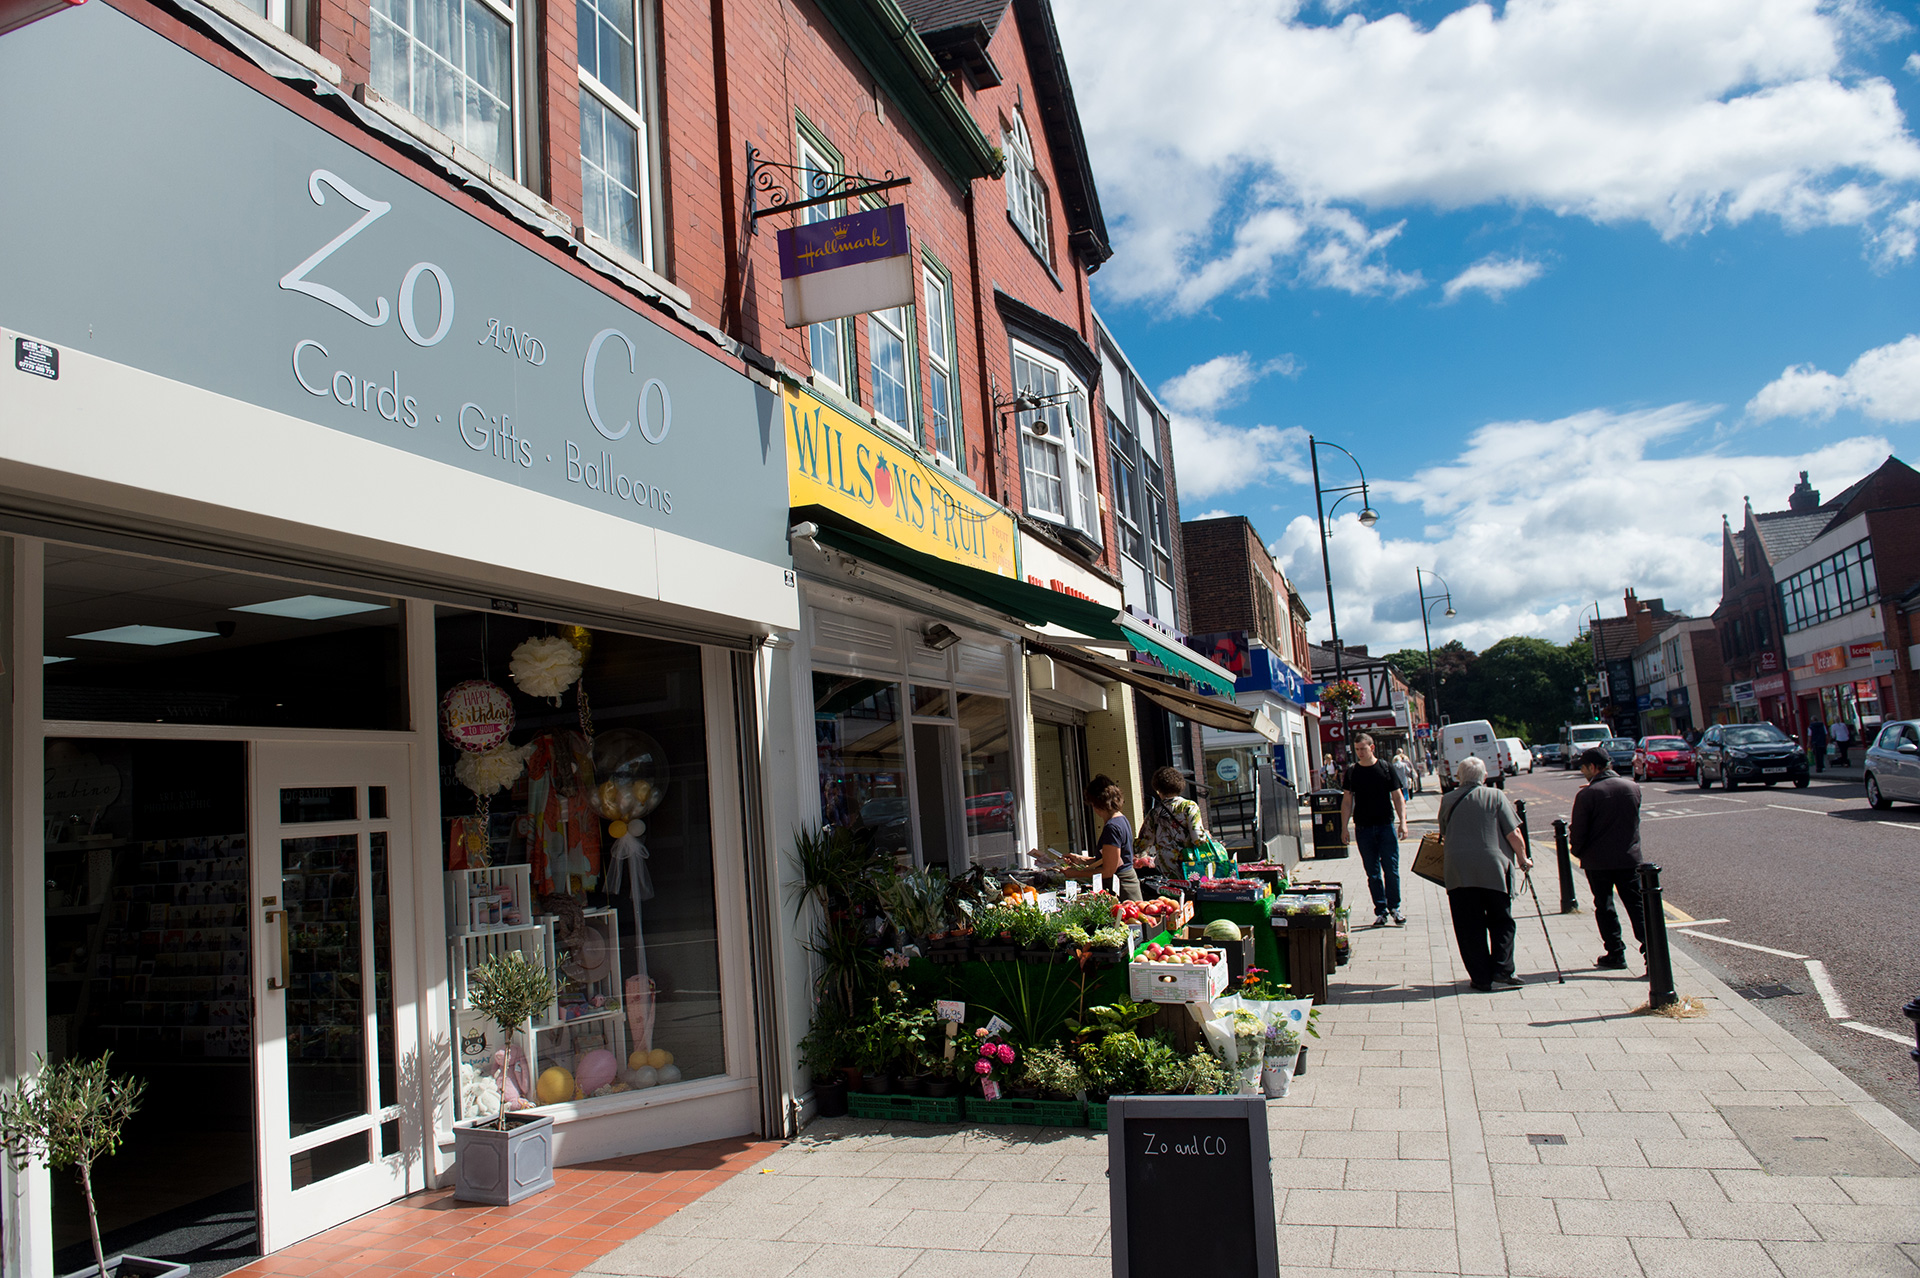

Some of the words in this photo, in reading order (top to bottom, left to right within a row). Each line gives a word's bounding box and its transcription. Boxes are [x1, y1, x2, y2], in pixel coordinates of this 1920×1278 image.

[797, 227, 889, 268] Hallmark
[279, 168, 455, 347] Zo
[478, 317, 547, 366] AND
[582, 327, 672, 444] Co
[292, 339, 420, 429] Cards
[458, 402, 534, 468] Gifts
[565, 440, 673, 515] Balloons
[788, 402, 925, 530] WILSONS
[930, 484, 988, 560] FRUIT
[991, 525, 1009, 544] FRUIT
[463, 690, 491, 706] HAPPY
[447, 702, 510, 728] Birthday
[469, 726, 478, 735] to
[480, 724, 495, 735] you!
[1143, 1132, 1169, 1155] Zo
[1175, 1135, 1200, 1156] and
